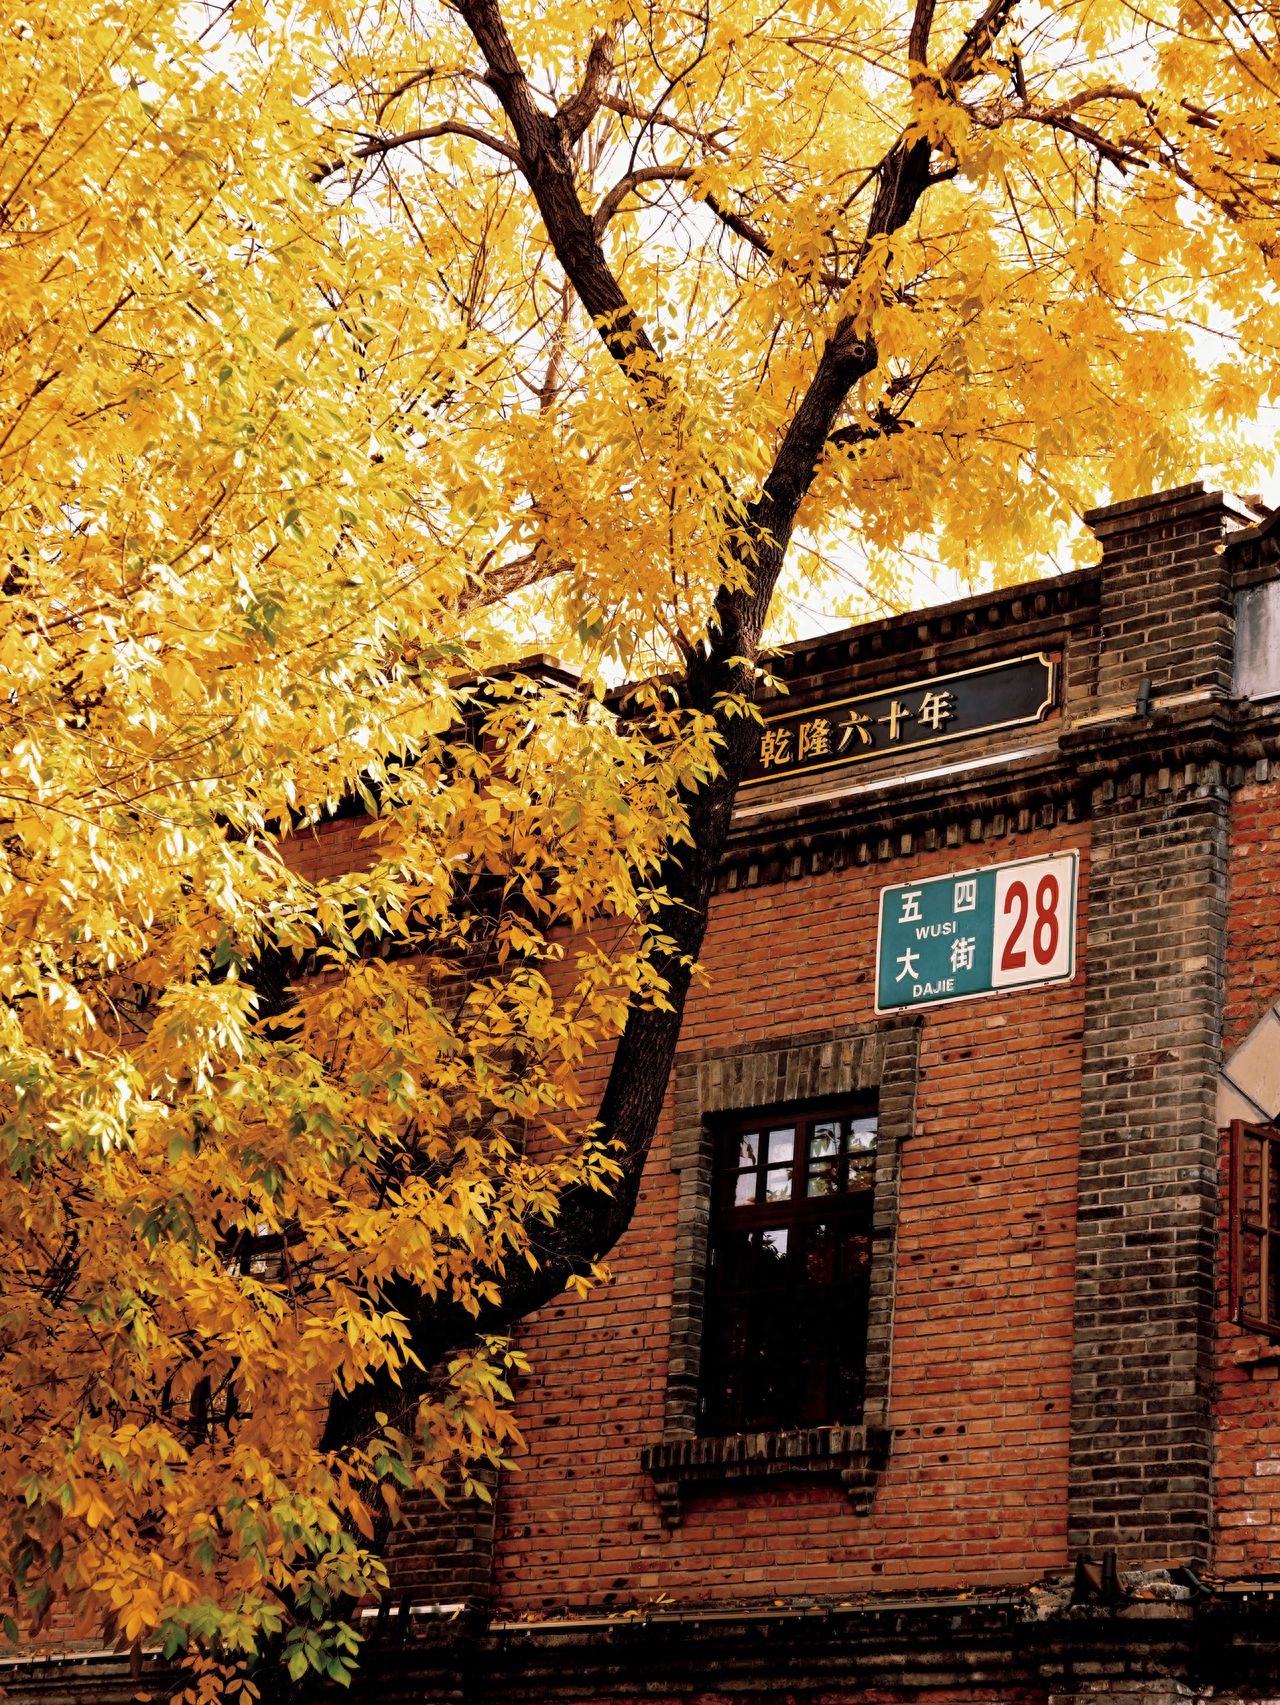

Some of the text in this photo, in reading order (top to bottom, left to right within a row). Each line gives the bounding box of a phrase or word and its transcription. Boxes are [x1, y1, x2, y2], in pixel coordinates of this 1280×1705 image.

[760, 691, 953, 768] 乾隆六十年
[916, 921, 957, 940] WUSI
[1001, 874, 1059, 971] 28
[912, 978, 955, 998] DAJIE
